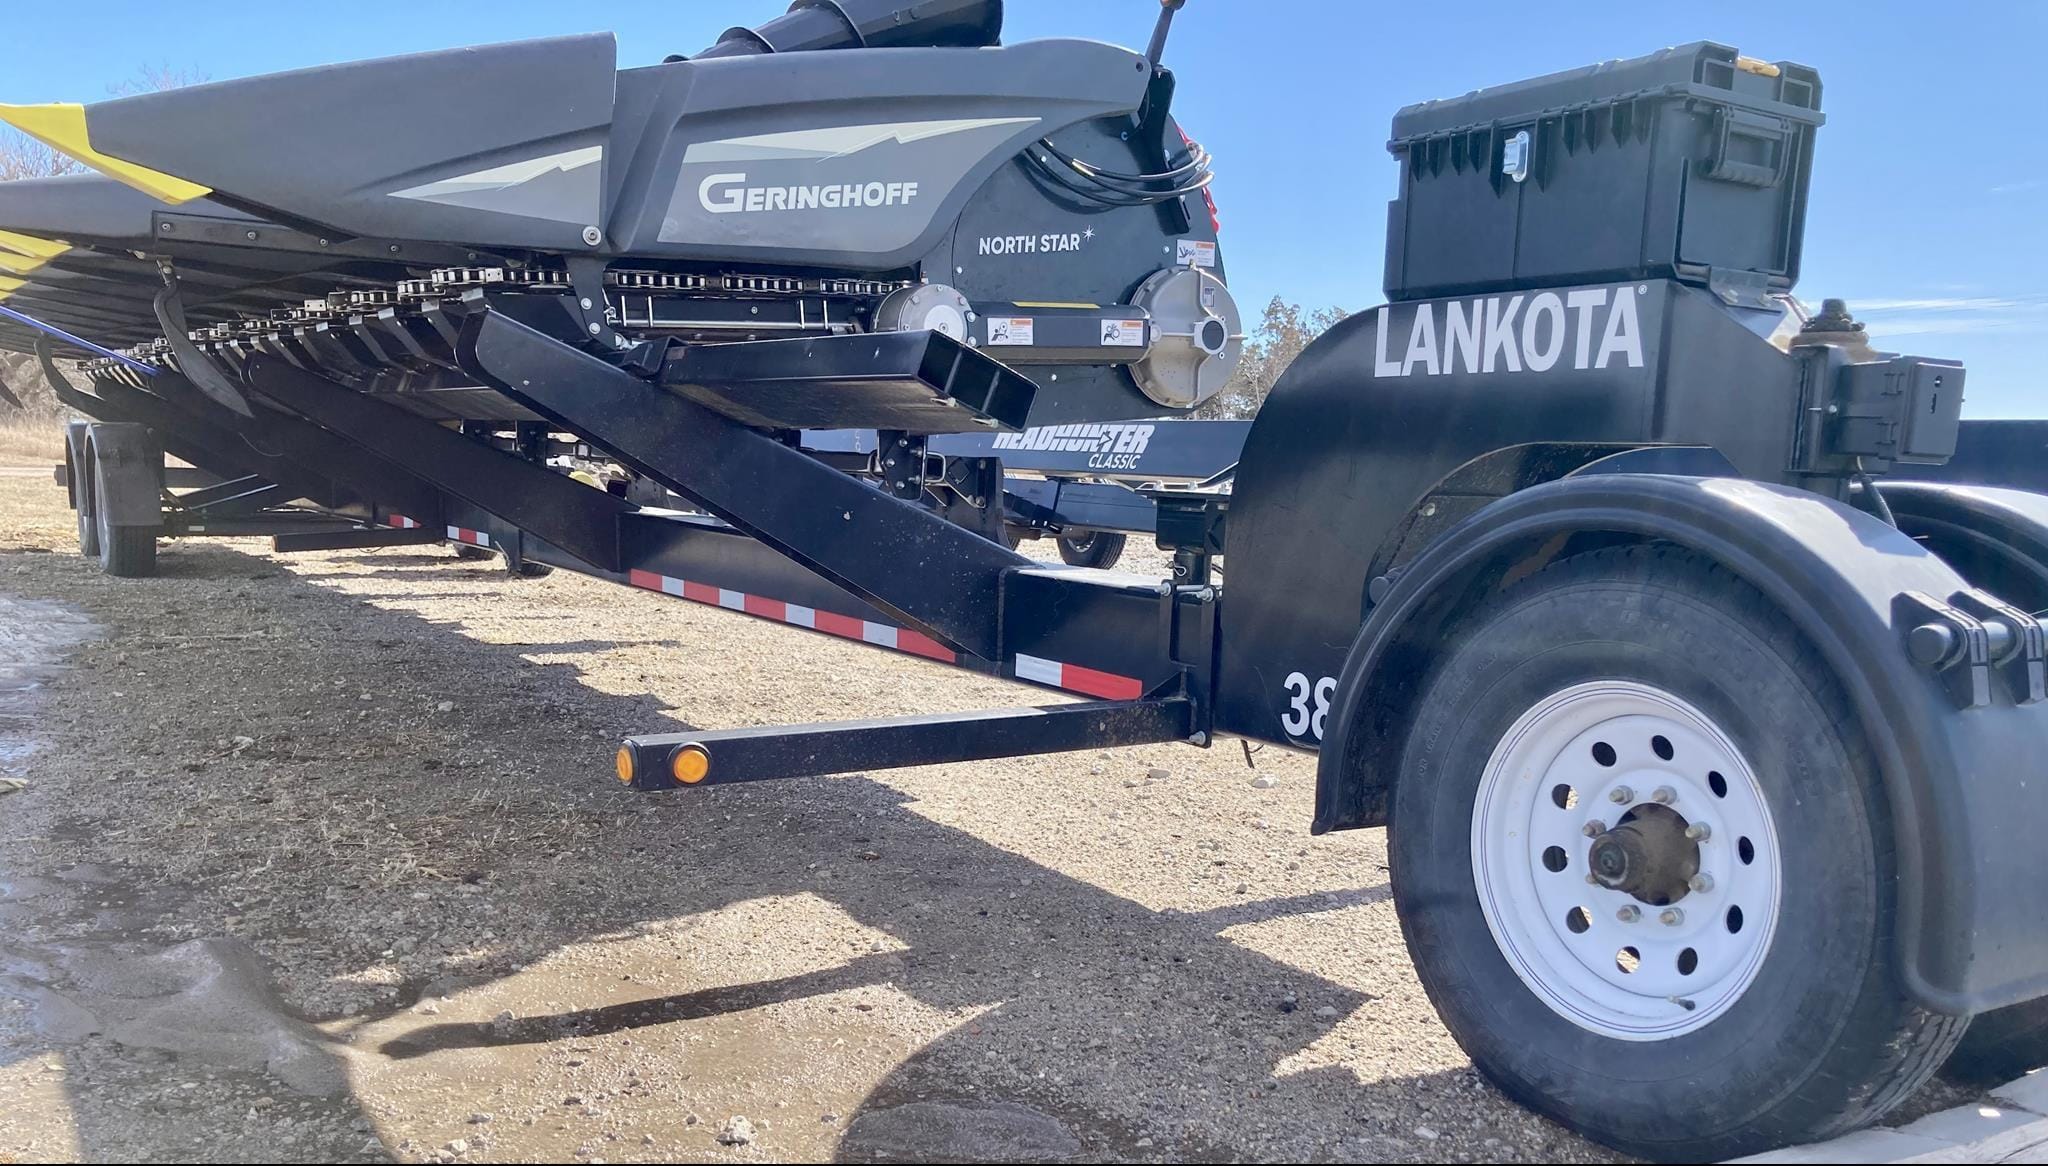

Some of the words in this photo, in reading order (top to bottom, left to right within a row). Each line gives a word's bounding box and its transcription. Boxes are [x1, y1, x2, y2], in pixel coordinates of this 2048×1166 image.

[698, 172, 918, 214] GERINGHOFF
[979, 235, 1036, 255] NORTH
[1040, 233, 1080, 253] STAR
[1088, 453, 1142, 469] CLASSIC
